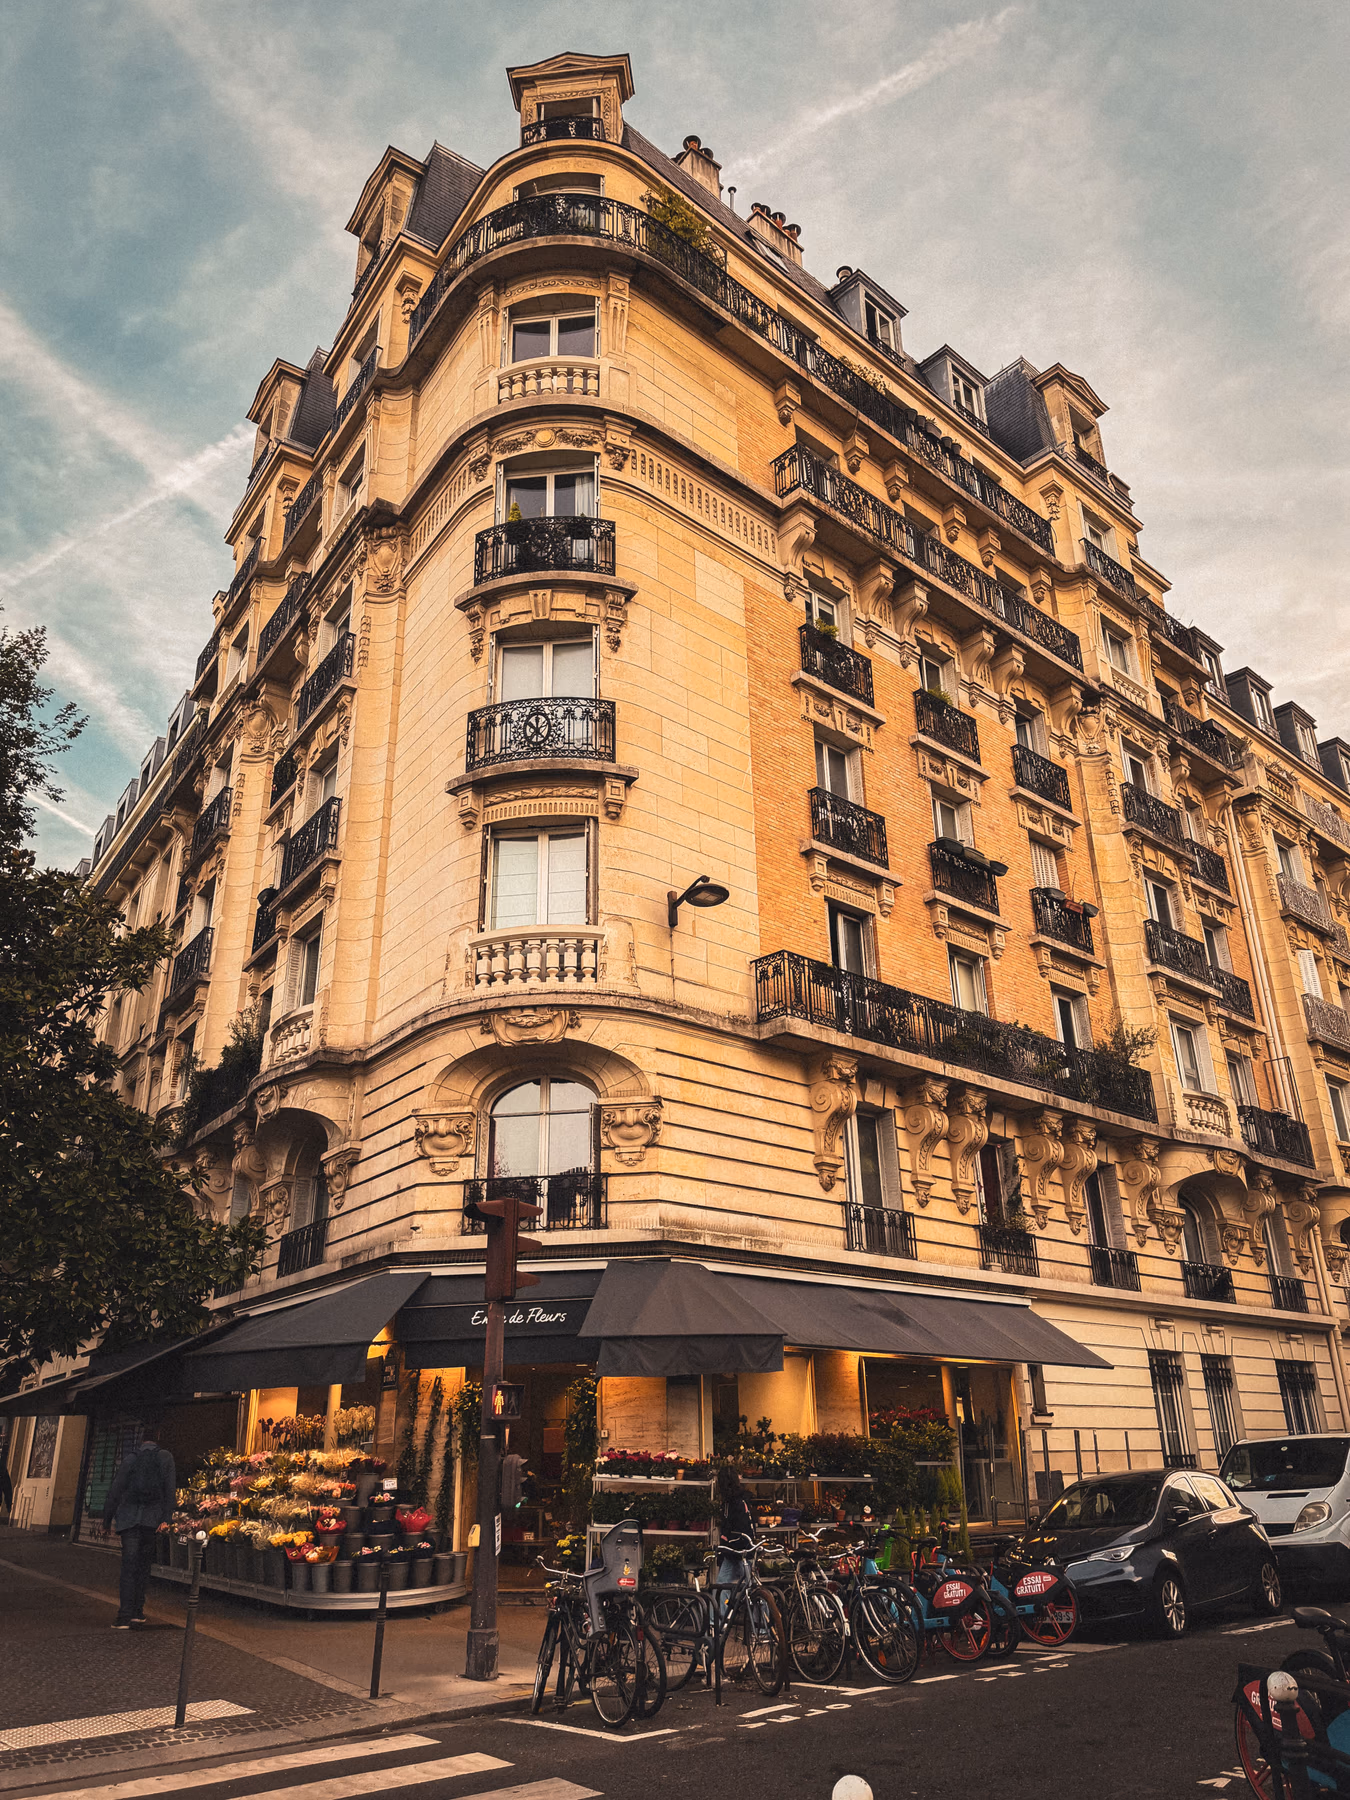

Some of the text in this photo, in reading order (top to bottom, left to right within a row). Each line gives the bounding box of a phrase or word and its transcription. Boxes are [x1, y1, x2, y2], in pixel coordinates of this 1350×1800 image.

[509, 1309, 524, 1324] de
[526, 1307, 567, 1323] Fleurs
[1022, 1575, 1042, 1585] ESSAI
